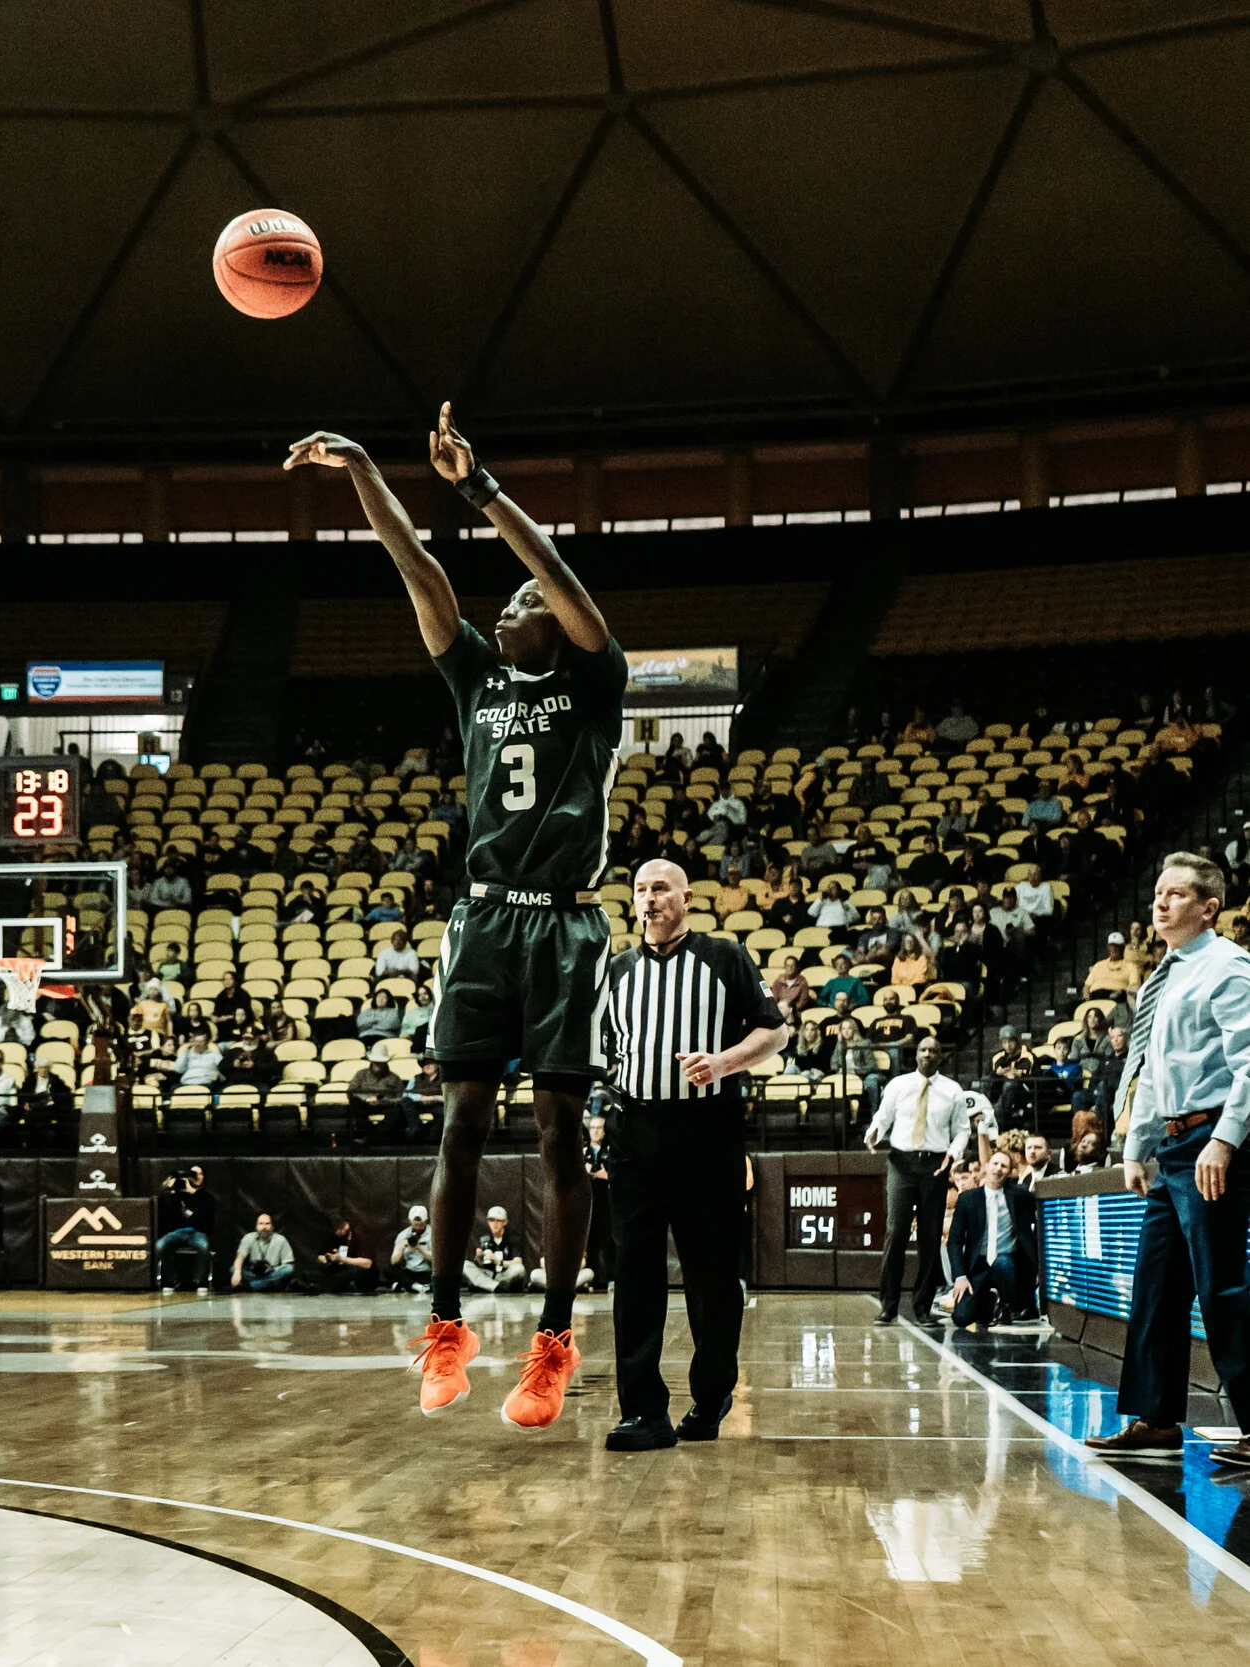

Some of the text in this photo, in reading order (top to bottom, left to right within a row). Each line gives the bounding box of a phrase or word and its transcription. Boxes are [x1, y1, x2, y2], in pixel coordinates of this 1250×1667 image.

[475, 695, 572, 725] COLORADO
[492, 715, 551, 739] STATE
[15, 769, 69, 793] 13:18
[501, 743, 536, 812] 3
[13, 795, 63, 837] 23
[506, 890, 552, 906] RAMS
[790, 1186, 837, 1208] HOME
[801, 1214, 835, 1245] 54
[51, 1250, 148, 1260] WESTERN STATES
[83, 1261, 114, 1270] BANK
